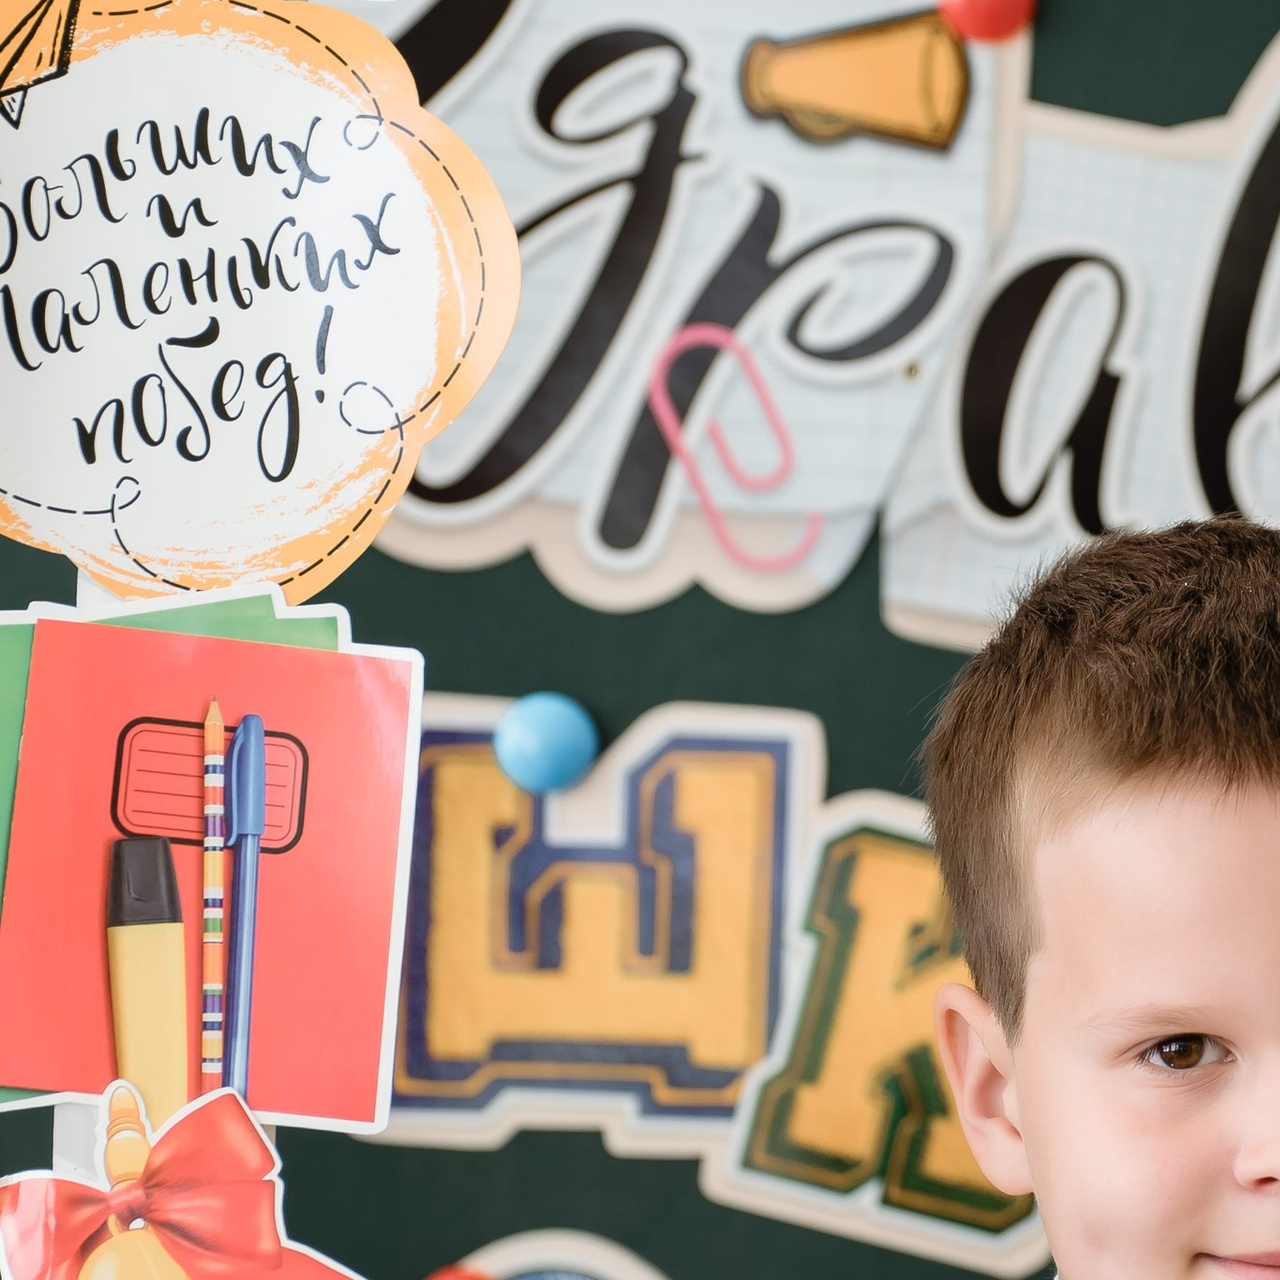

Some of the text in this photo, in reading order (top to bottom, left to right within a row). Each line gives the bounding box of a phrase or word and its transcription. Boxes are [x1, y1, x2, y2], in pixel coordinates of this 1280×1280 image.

[0, 106, 330, 273] ольших
[146, 193, 219, 238] и
[72, 305, 334, 482] побед!
